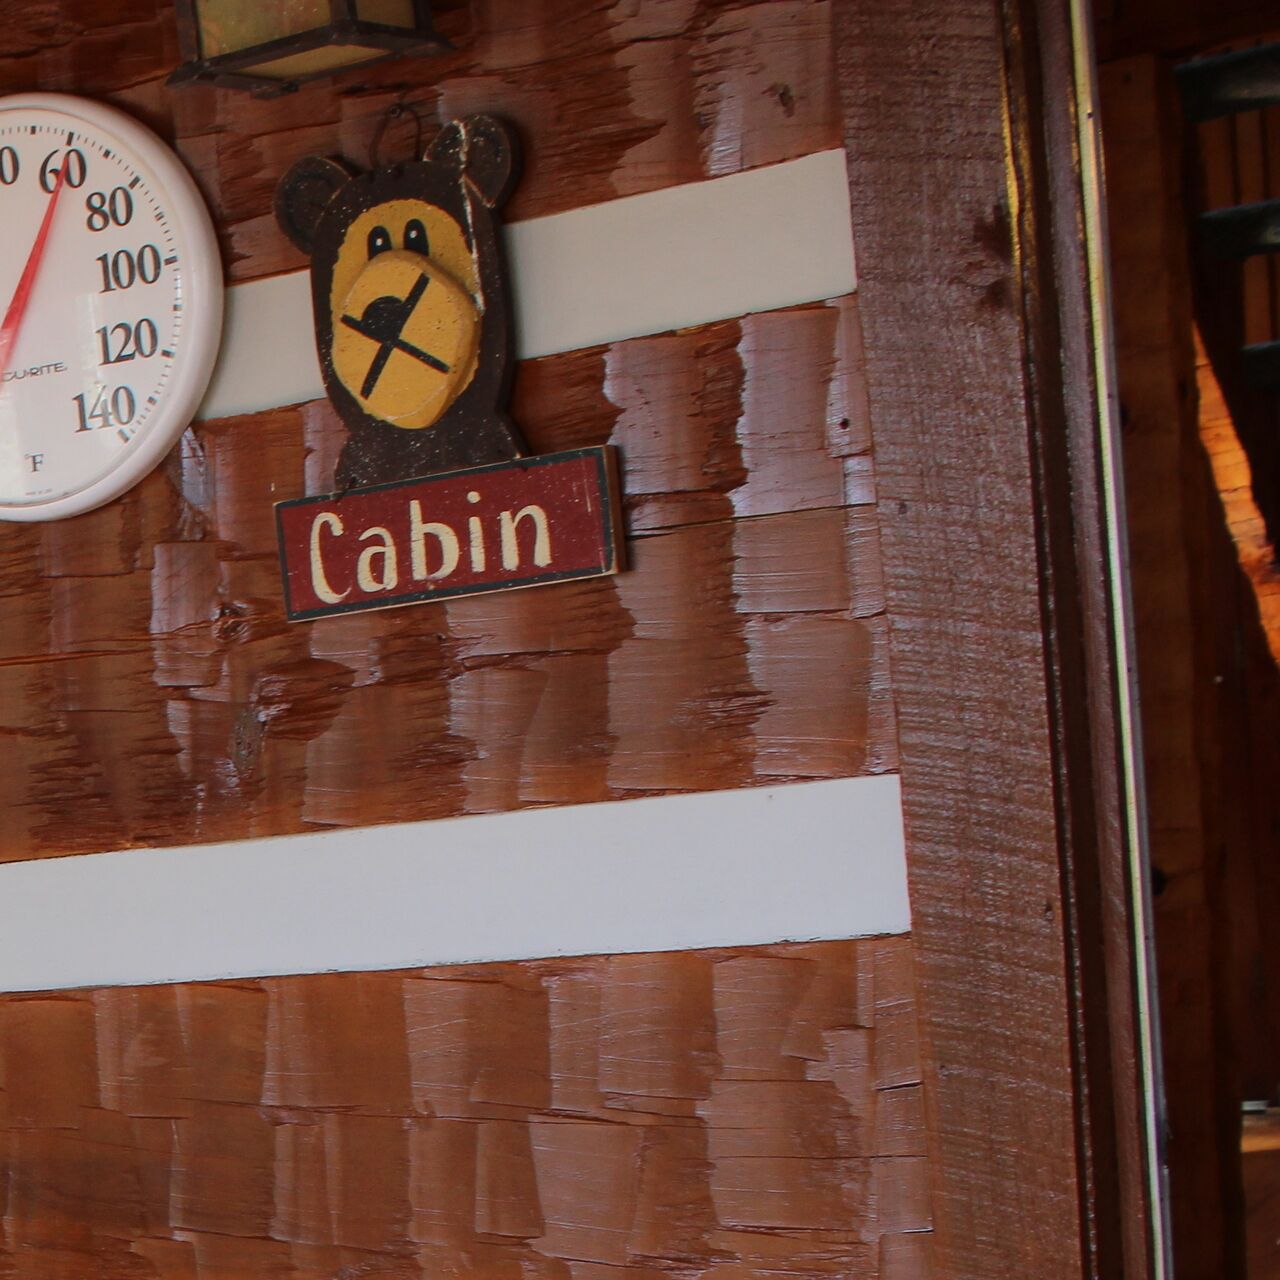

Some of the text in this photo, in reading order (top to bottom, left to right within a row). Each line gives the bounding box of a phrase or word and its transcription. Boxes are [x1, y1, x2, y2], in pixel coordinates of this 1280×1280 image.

[40, 148, 88, 194] 60
[86, 186, 134, 232] 80
[96, 243, 162, 294] 100
[96, 317, 159, 366] 120
[71, 384, 136, 433] 140
[309, 490, 553, 605] Cabin
